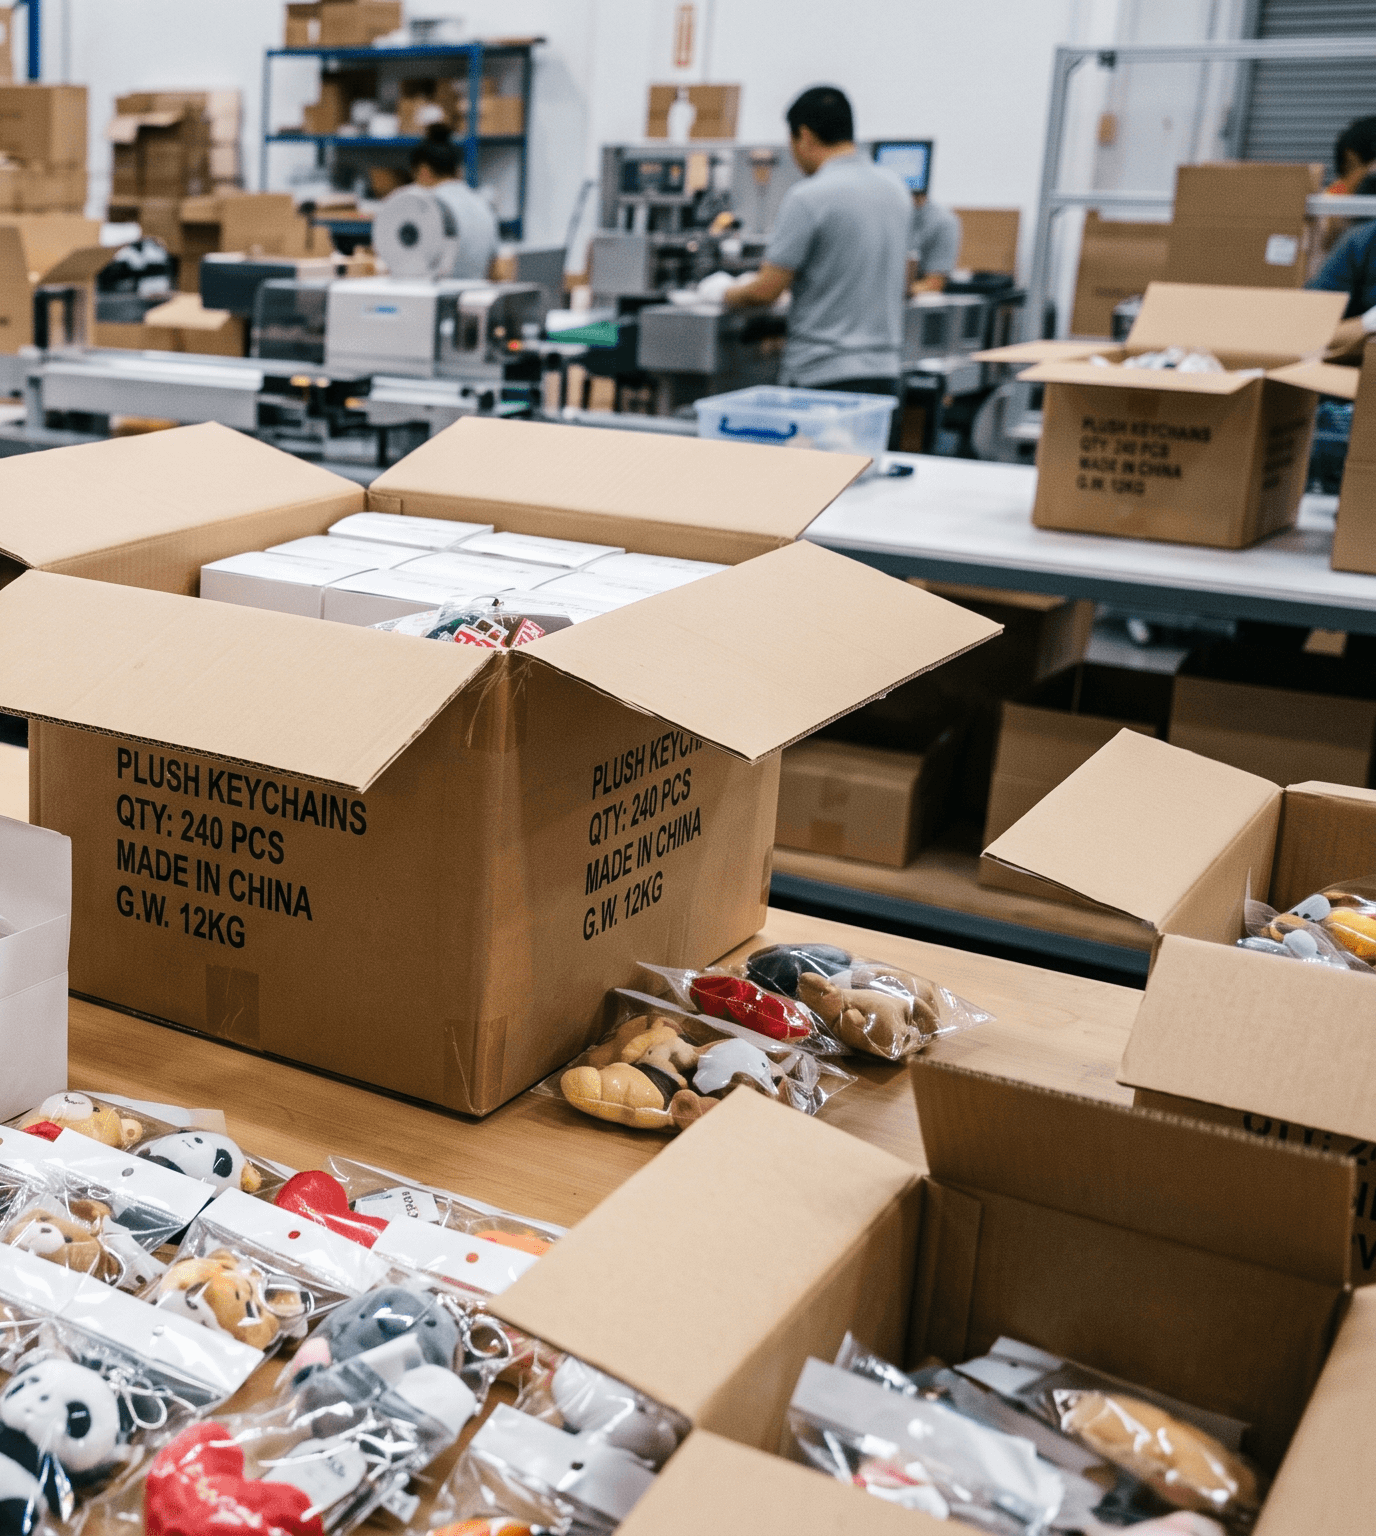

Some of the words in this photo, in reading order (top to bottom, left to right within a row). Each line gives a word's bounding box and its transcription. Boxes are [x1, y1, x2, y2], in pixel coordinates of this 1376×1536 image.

[117, 747, 199, 797] PLUSH
[208, 767, 367, 836] KEYCHAINS
[589, 800, 626, 846] QTY:
[630, 785, 658, 827] 240
[661, 767, 692, 812] PCS
[592, 744, 646, 800] PLUSH
[117, 794, 172, 838] QTY:
[180, 809, 223, 850] 240
[231, 820, 284, 865] PCS
[585, 841, 634, 896] MADE
[636, 831, 653, 869] IN
[656, 807, 702, 858] CHINA
[116, 884, 169, 928] G.W.
[180, 902, 245, 949] 12KG
[117, 838, 188, 888] MADE
[196, 859, 220, 896] IN
[228, 868, 313, 921] CHINA
[583, 894, 618, 941] G.W.
[624, 870, 663, 919] 12KG
